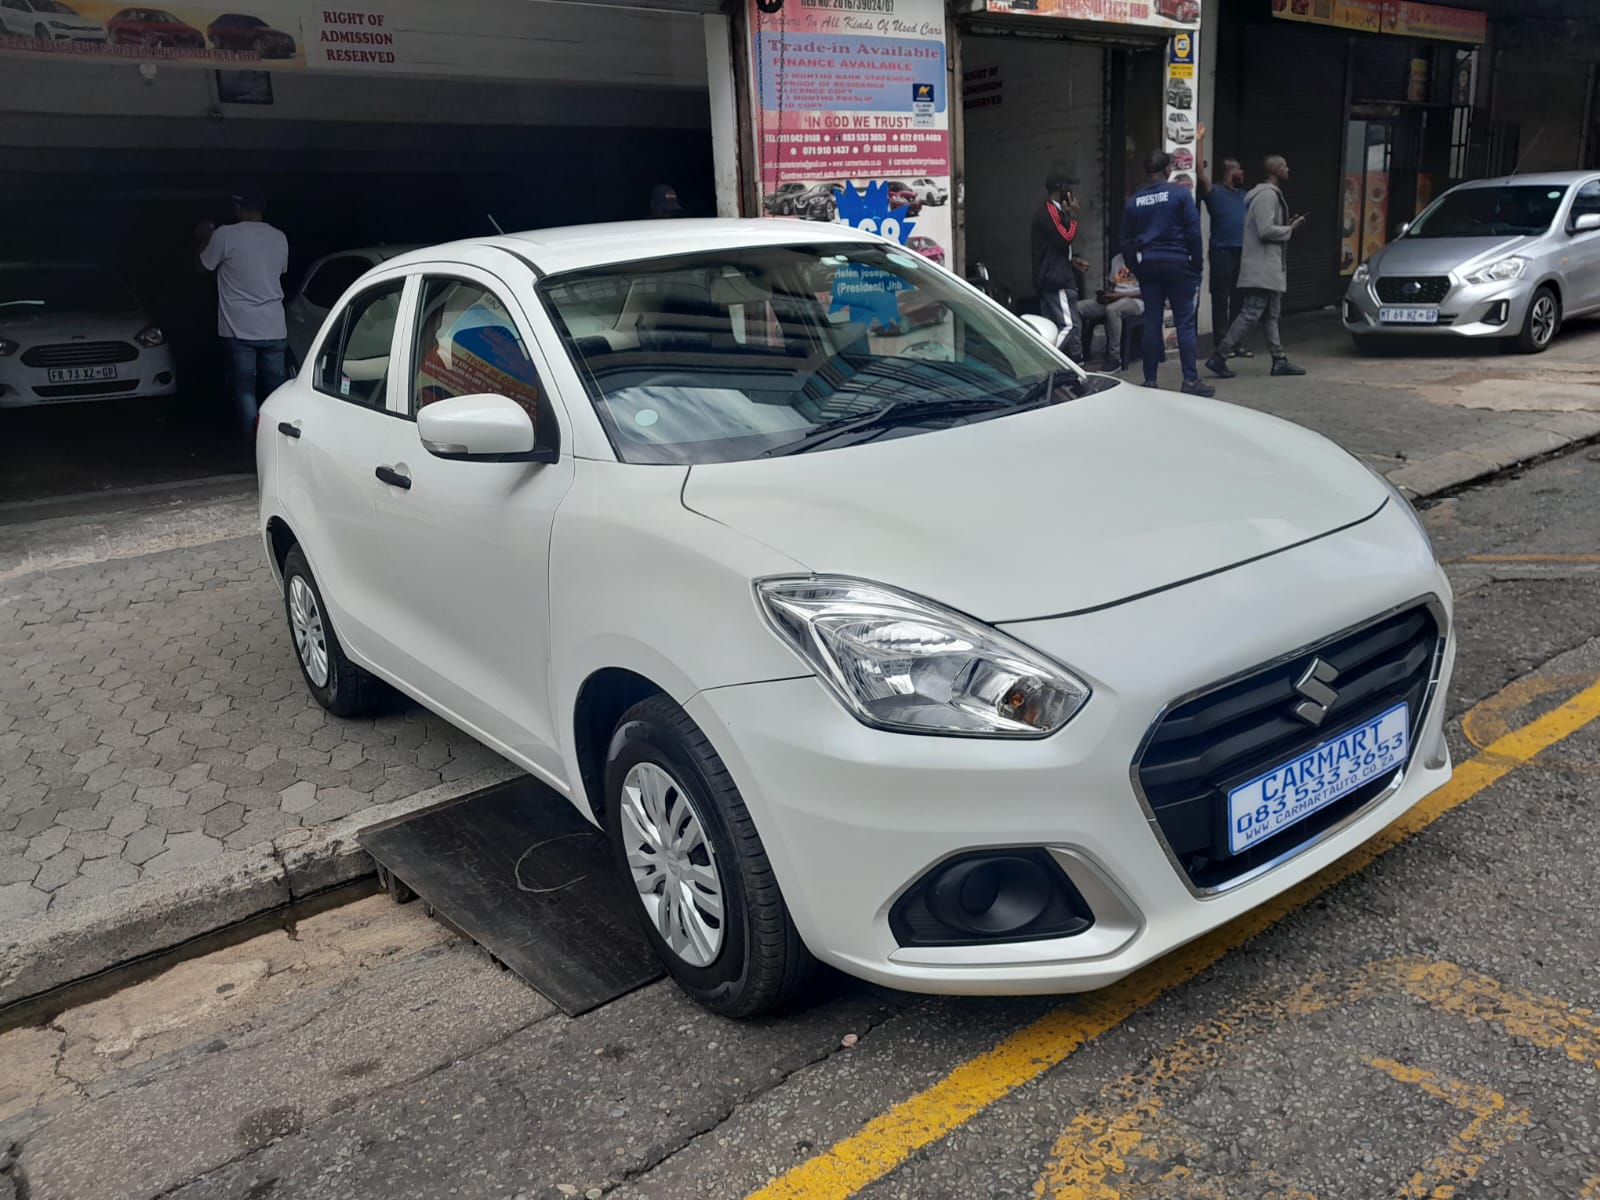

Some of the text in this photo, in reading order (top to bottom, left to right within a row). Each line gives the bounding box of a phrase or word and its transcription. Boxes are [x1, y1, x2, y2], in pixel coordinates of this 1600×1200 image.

[323, 11, 384, 26] RIGHT OF
[821, 15, 840, 29] All
[844, 16, 873, 30] Kinds
[877, 18, 889, 34] Of
[892, 20, 917, 33] Used
[920, 23, 942, 36] Cars
[321, 30, 393, 45] ADMISSION
[768, 39, 939, 58] Trade-in Available
[326, 49, 395, 64] RESERVED
[773, 58, 912, 71] FINANCE AVAILABLE
[825, 116, 849, 127] GOD
[852, 116, 870, 127] WE
[1136, 191, 1169, 207] PRESTIGE
[837, 280, 902, 296] (President) Jhb
[68, 369, 79, 379] 73
[1261, 720, 1383, 802] CARMART
[1237, 732, 1403, 833] 083 533 3653
